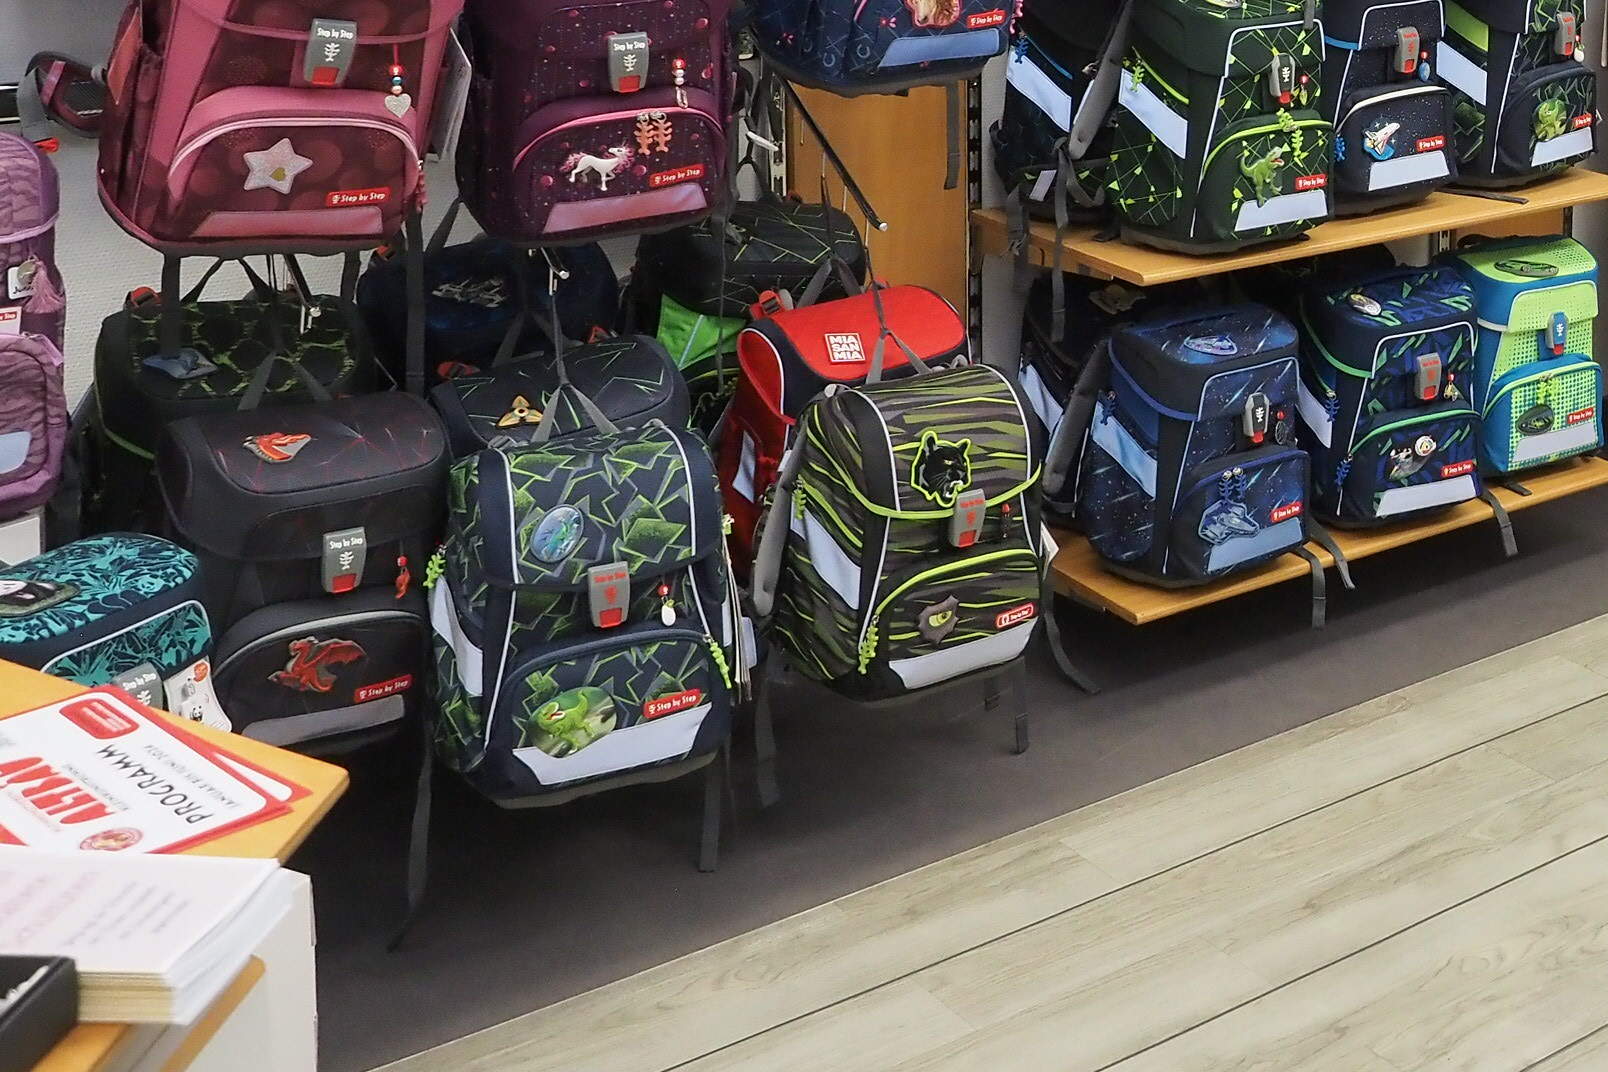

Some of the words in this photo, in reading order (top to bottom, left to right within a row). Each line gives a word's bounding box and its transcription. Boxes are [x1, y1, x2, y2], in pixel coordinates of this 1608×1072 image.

[341, 194, 358, 204] Step
[359, 193, 369, 202] by
[370, 192, 386, 201] Step
[830, 335, 859, 344] MIA
[832, 343, 861, 351] SAN
[834, 351, 865, 360] MIA
[656, 701, 672, 712] Step
[682, 695, 697, 705] Step
[97, 743, 214, 824] PROGRAMM
